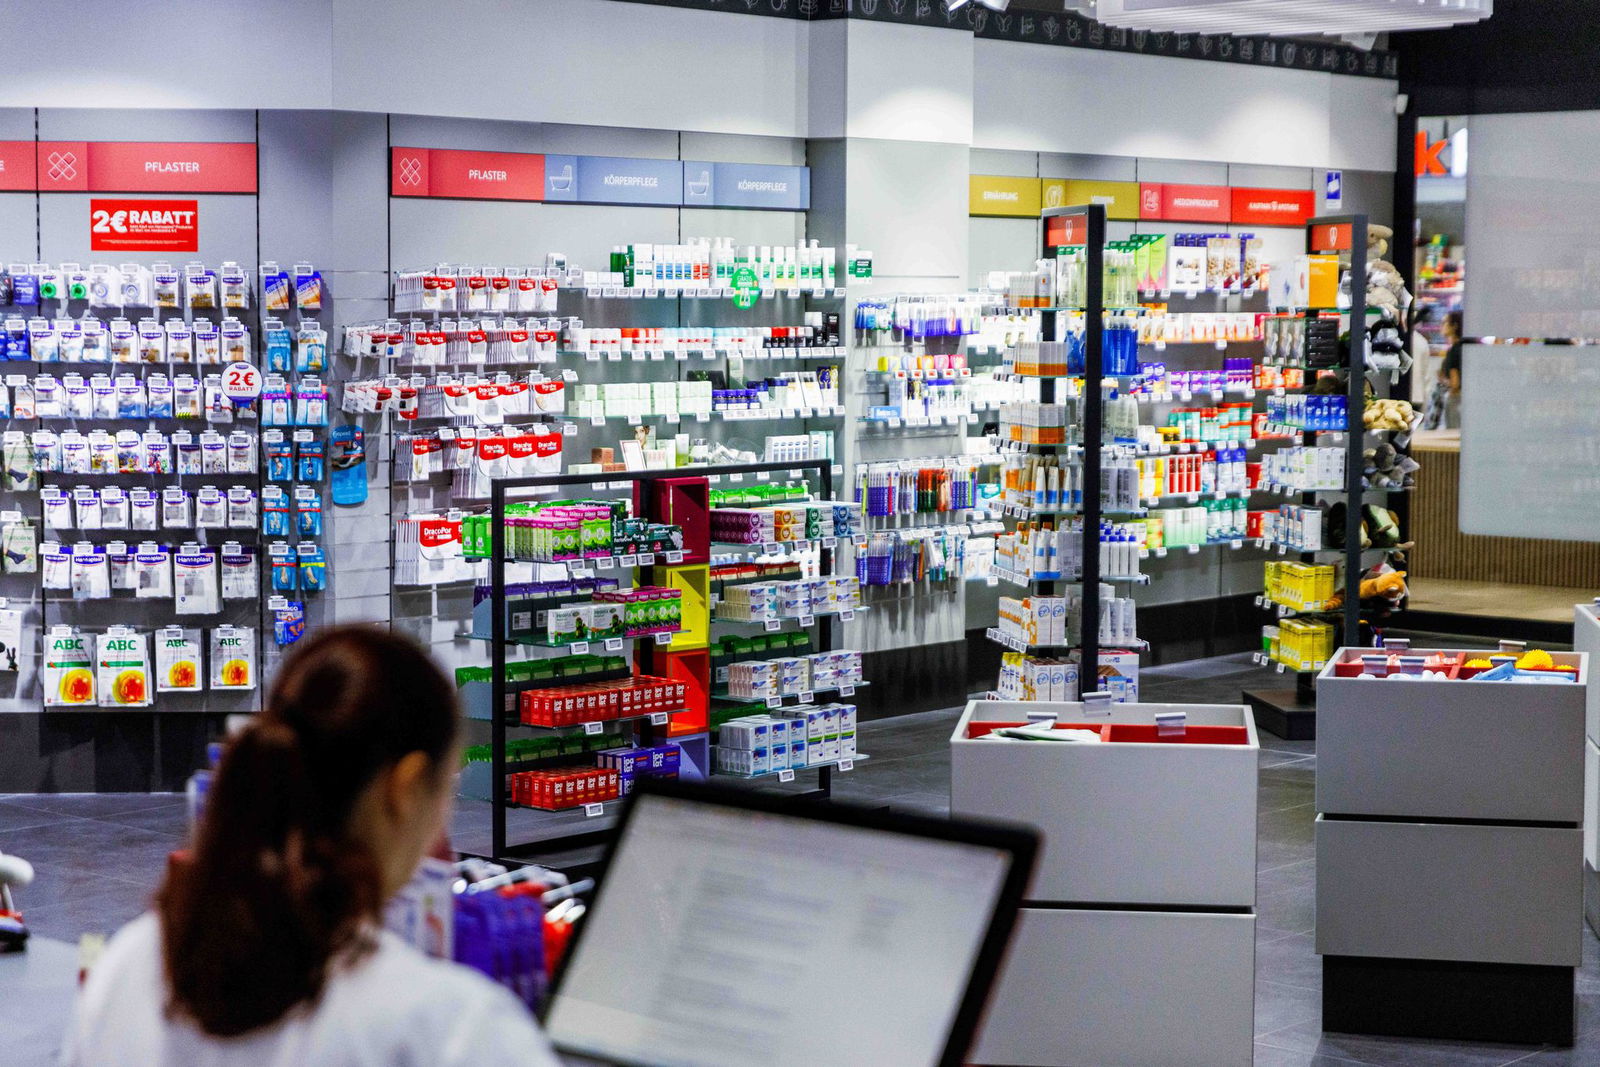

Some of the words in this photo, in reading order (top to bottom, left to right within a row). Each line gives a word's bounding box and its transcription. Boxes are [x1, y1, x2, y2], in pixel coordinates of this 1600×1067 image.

[144, 161, 200, 173] PFLASTER
[468, 169, 508, 181] PFLASTER
[604, 174, 659, 188] KÖRPERPFLEGE
[737, 179, 788, 193] KÖRPERPFLEGE
[92, 209, 128, 234] 2€
[128, 210, 195, 225] RABATT
[423, 526, 452, 537] DracoPor
[177, 556, 212, 564] Hansaplast
[53, 638, 84, 650] ABC
[106, 639, 137, 651] ABC
[166, 638, 189, 648] ABC
[220, 637, 242, 646] ABC
